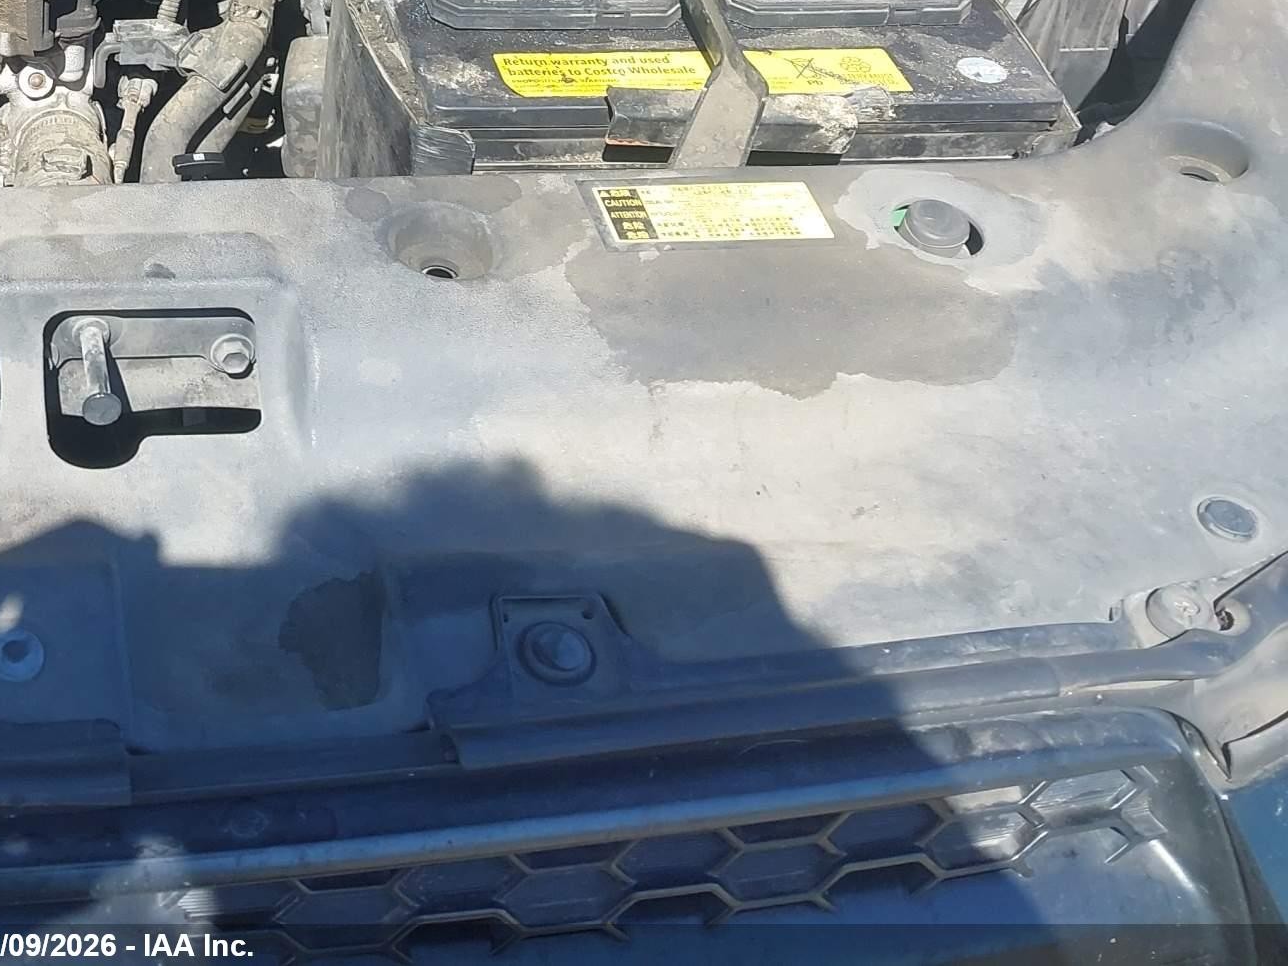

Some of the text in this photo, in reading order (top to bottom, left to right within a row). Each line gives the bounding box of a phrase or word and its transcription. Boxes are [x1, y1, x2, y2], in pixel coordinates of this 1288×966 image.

[503, 55, 670, 67] Return warranty and used
[508, 65, 697, 77] batteries to Costco Wholesale
[604, 198, 643, 207] CAUTION
[610, 211, 649, 219] ATTENTION
